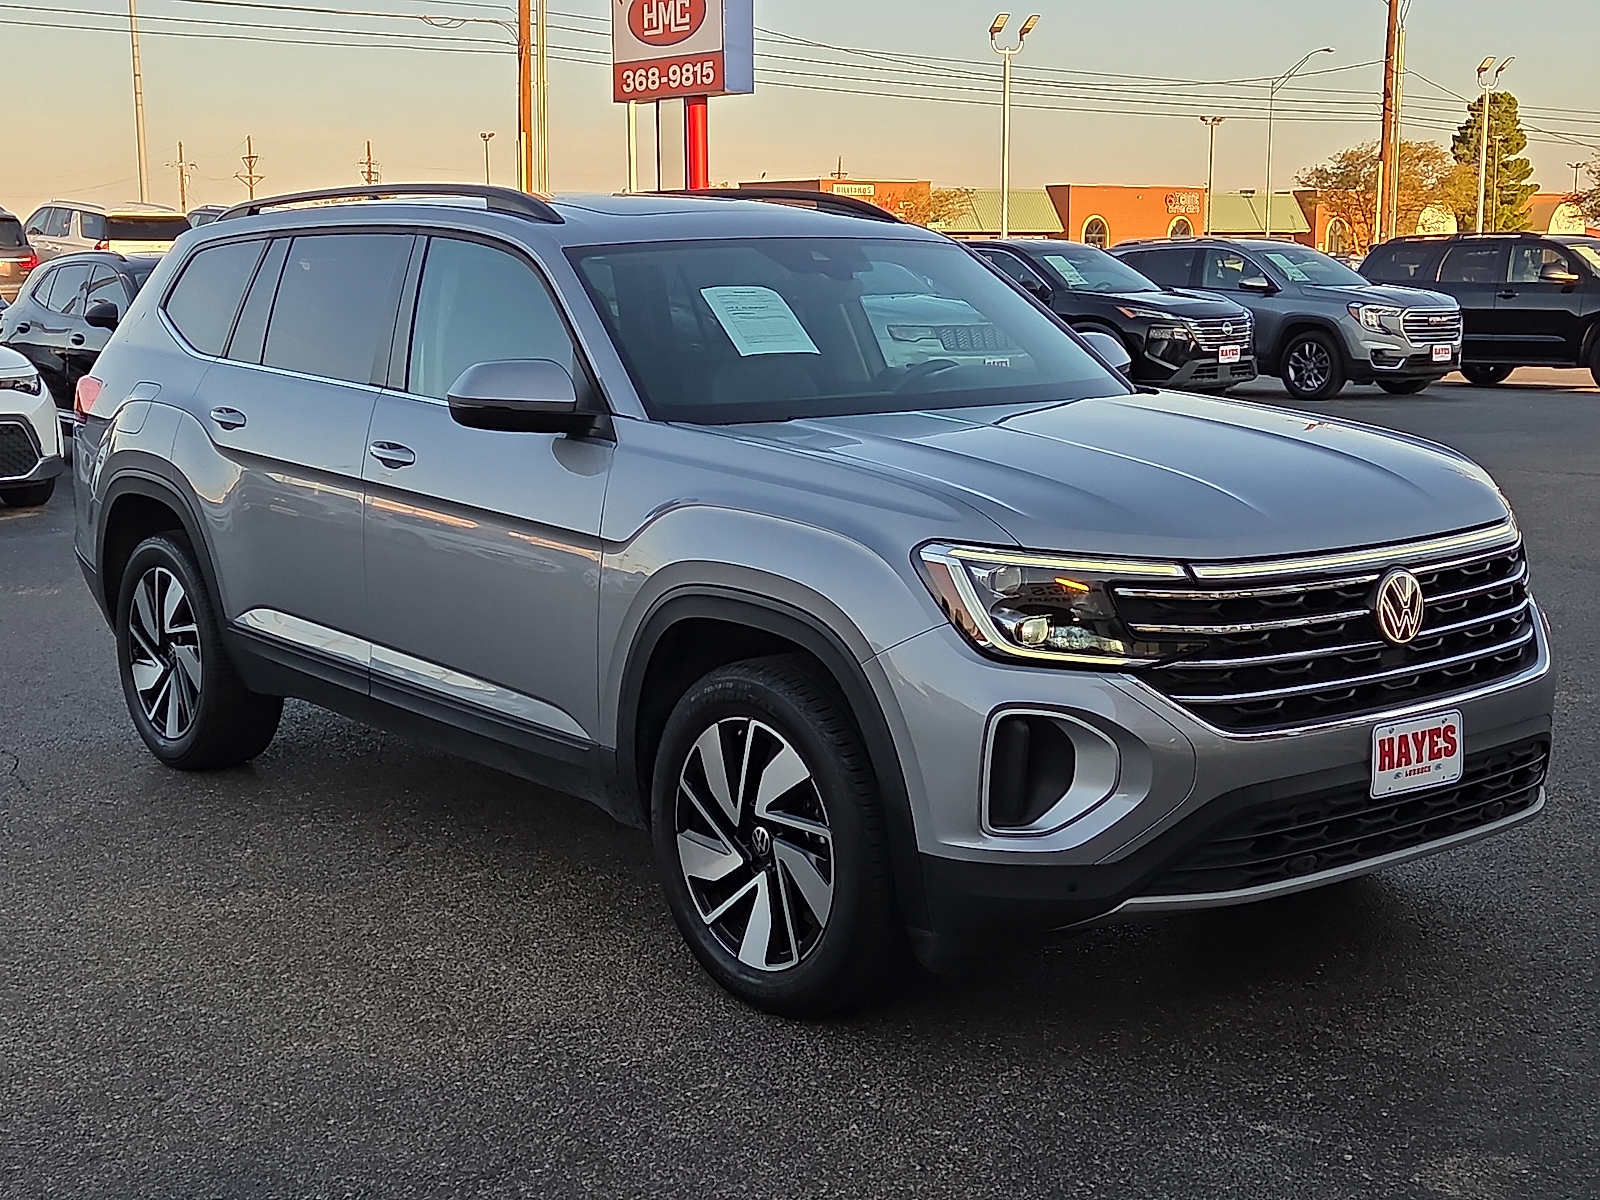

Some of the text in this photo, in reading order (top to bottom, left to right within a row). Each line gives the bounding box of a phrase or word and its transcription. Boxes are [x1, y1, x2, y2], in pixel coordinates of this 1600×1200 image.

[643, 0, 691, 36] HMC
[621, 60, 715, 93] 368-9815
[1378, 724, 1457, 772] HAYES
